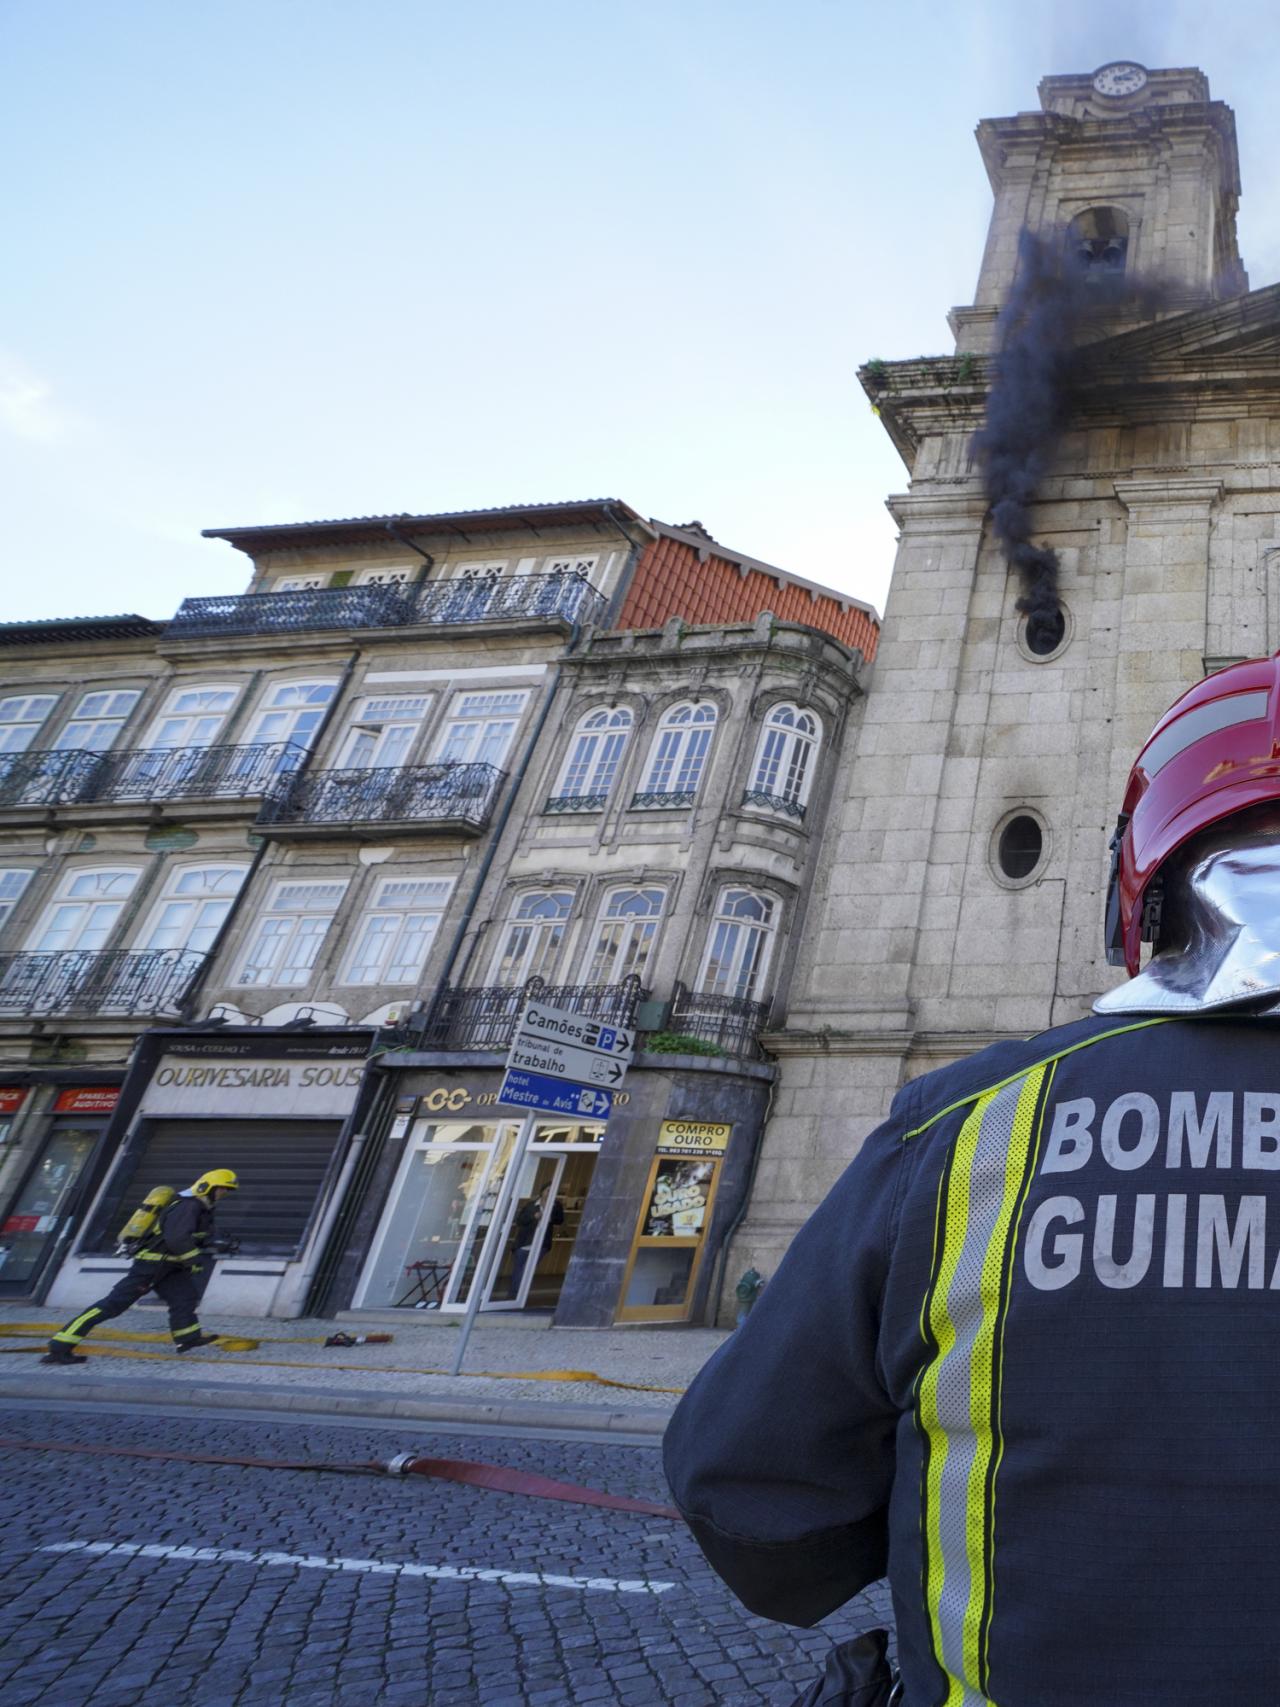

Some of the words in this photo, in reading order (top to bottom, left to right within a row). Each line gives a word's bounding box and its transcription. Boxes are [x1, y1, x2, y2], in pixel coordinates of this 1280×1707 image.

[526, 1010, 583, 1038] Camões
[601, 1033, 613, 1047] P
[517, 1038, 550, 1053] tribunal
[553, 1047, 563, 1056] de
[512, 1050, 566, 1073] trabalho
[156, 1067, 291, 1088] OURIVESARIA
[507, 1073, 530, 1087] hotel
[501, 1087, 540, 1104] Mestre
[666, 1123, 725, 1136] COMPRO
[674, 1134, 713, 1146] OURO
